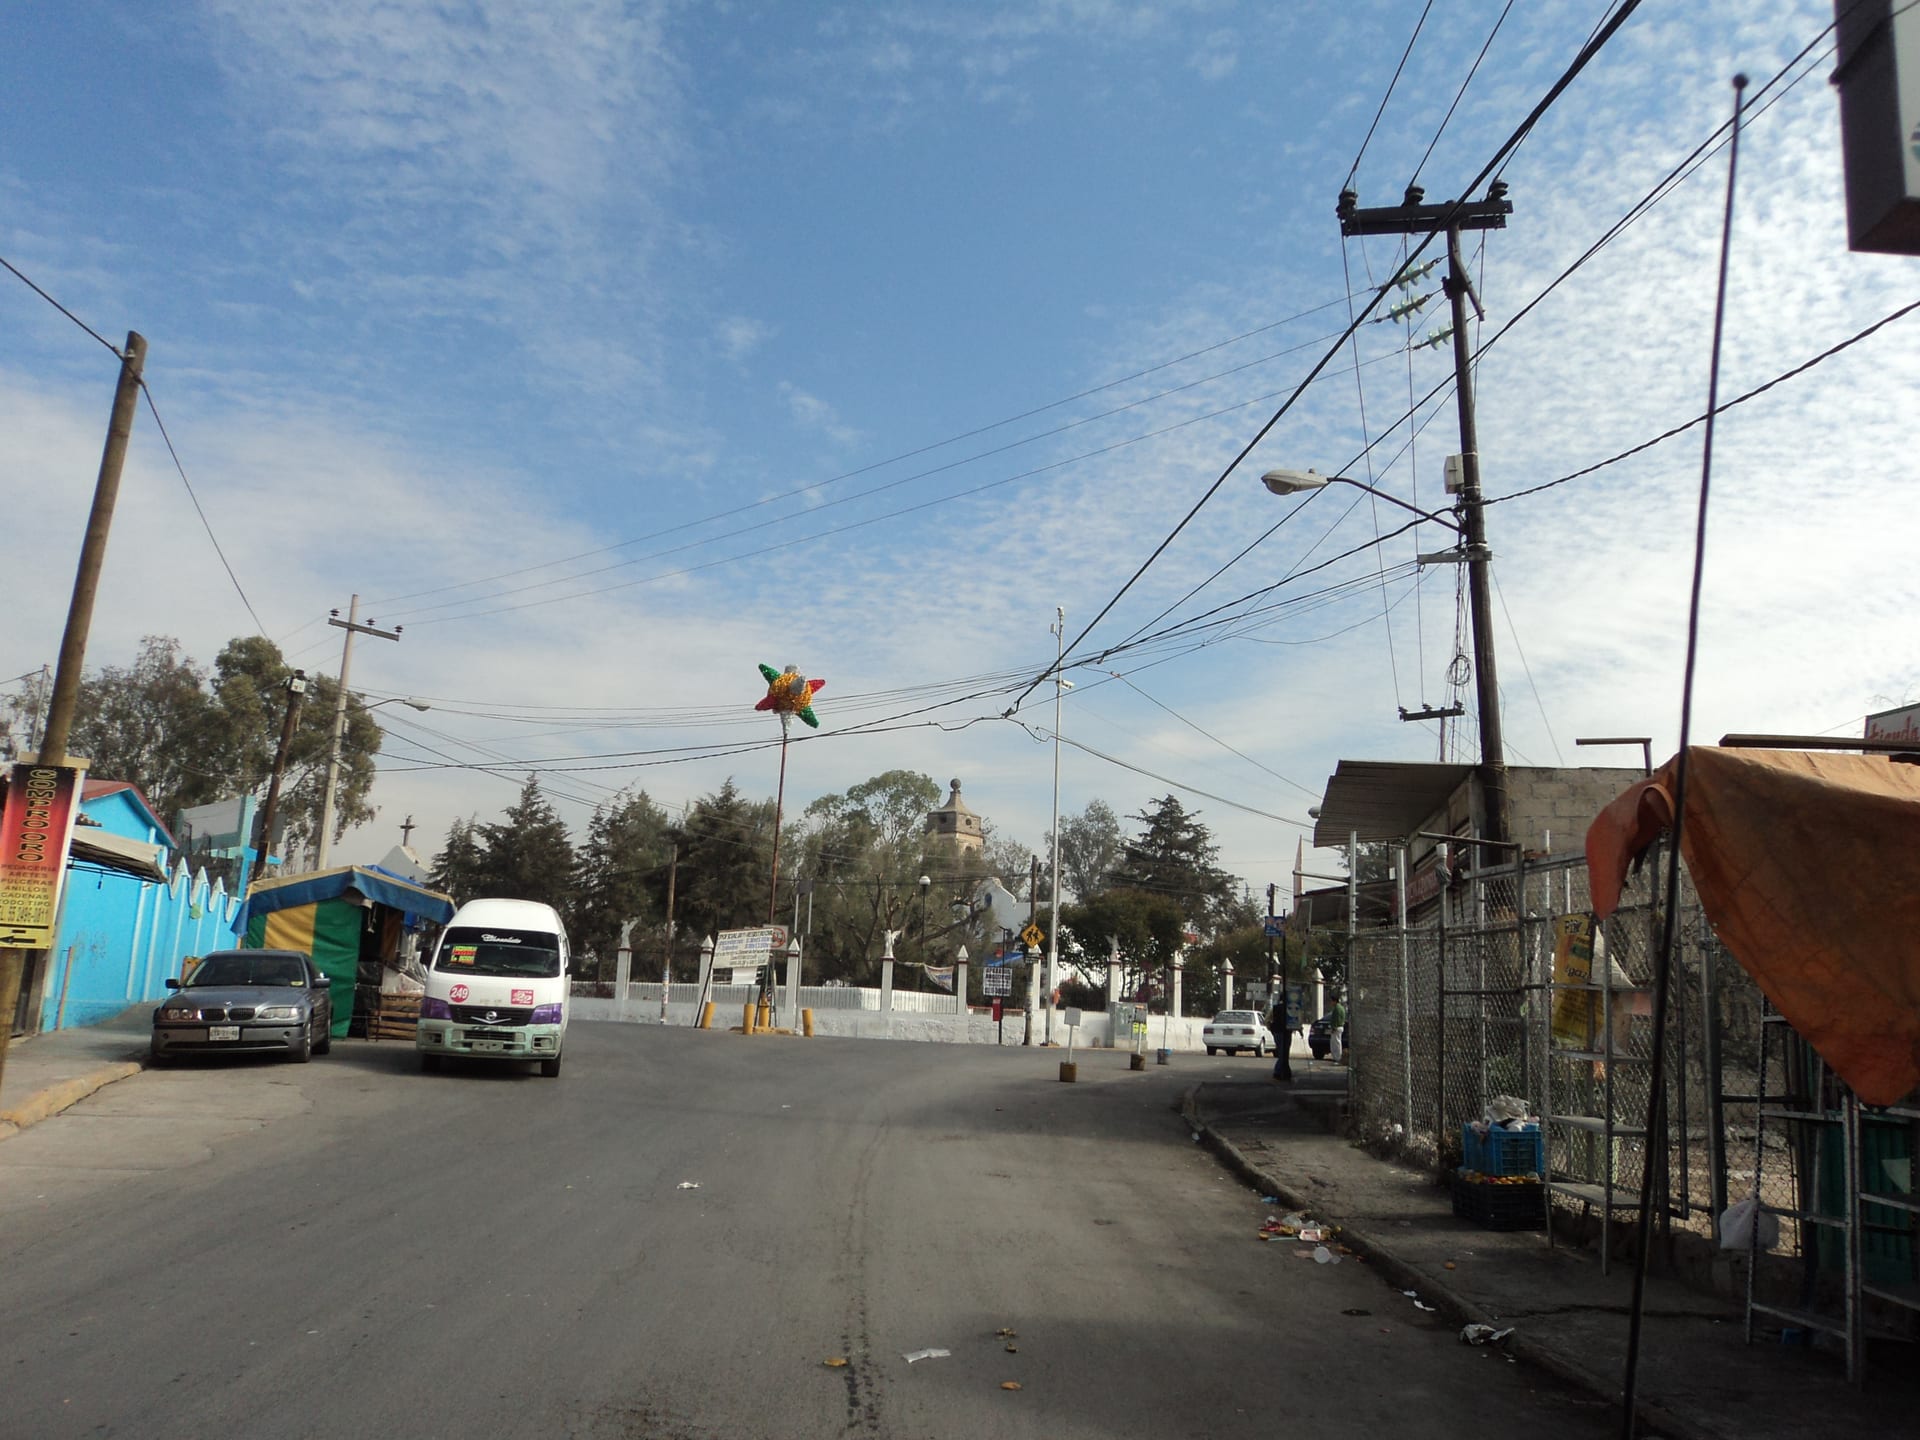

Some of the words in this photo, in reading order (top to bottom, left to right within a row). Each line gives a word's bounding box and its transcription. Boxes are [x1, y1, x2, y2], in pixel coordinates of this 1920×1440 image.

[23, 769, 57, 829] COMPRO
[17, 832, 47, 861] ORO
[5, 885, 48, 893] ANILLOS
[0, 892, 49, 900] CADENAS
[451, 988, 469, 998] 249
